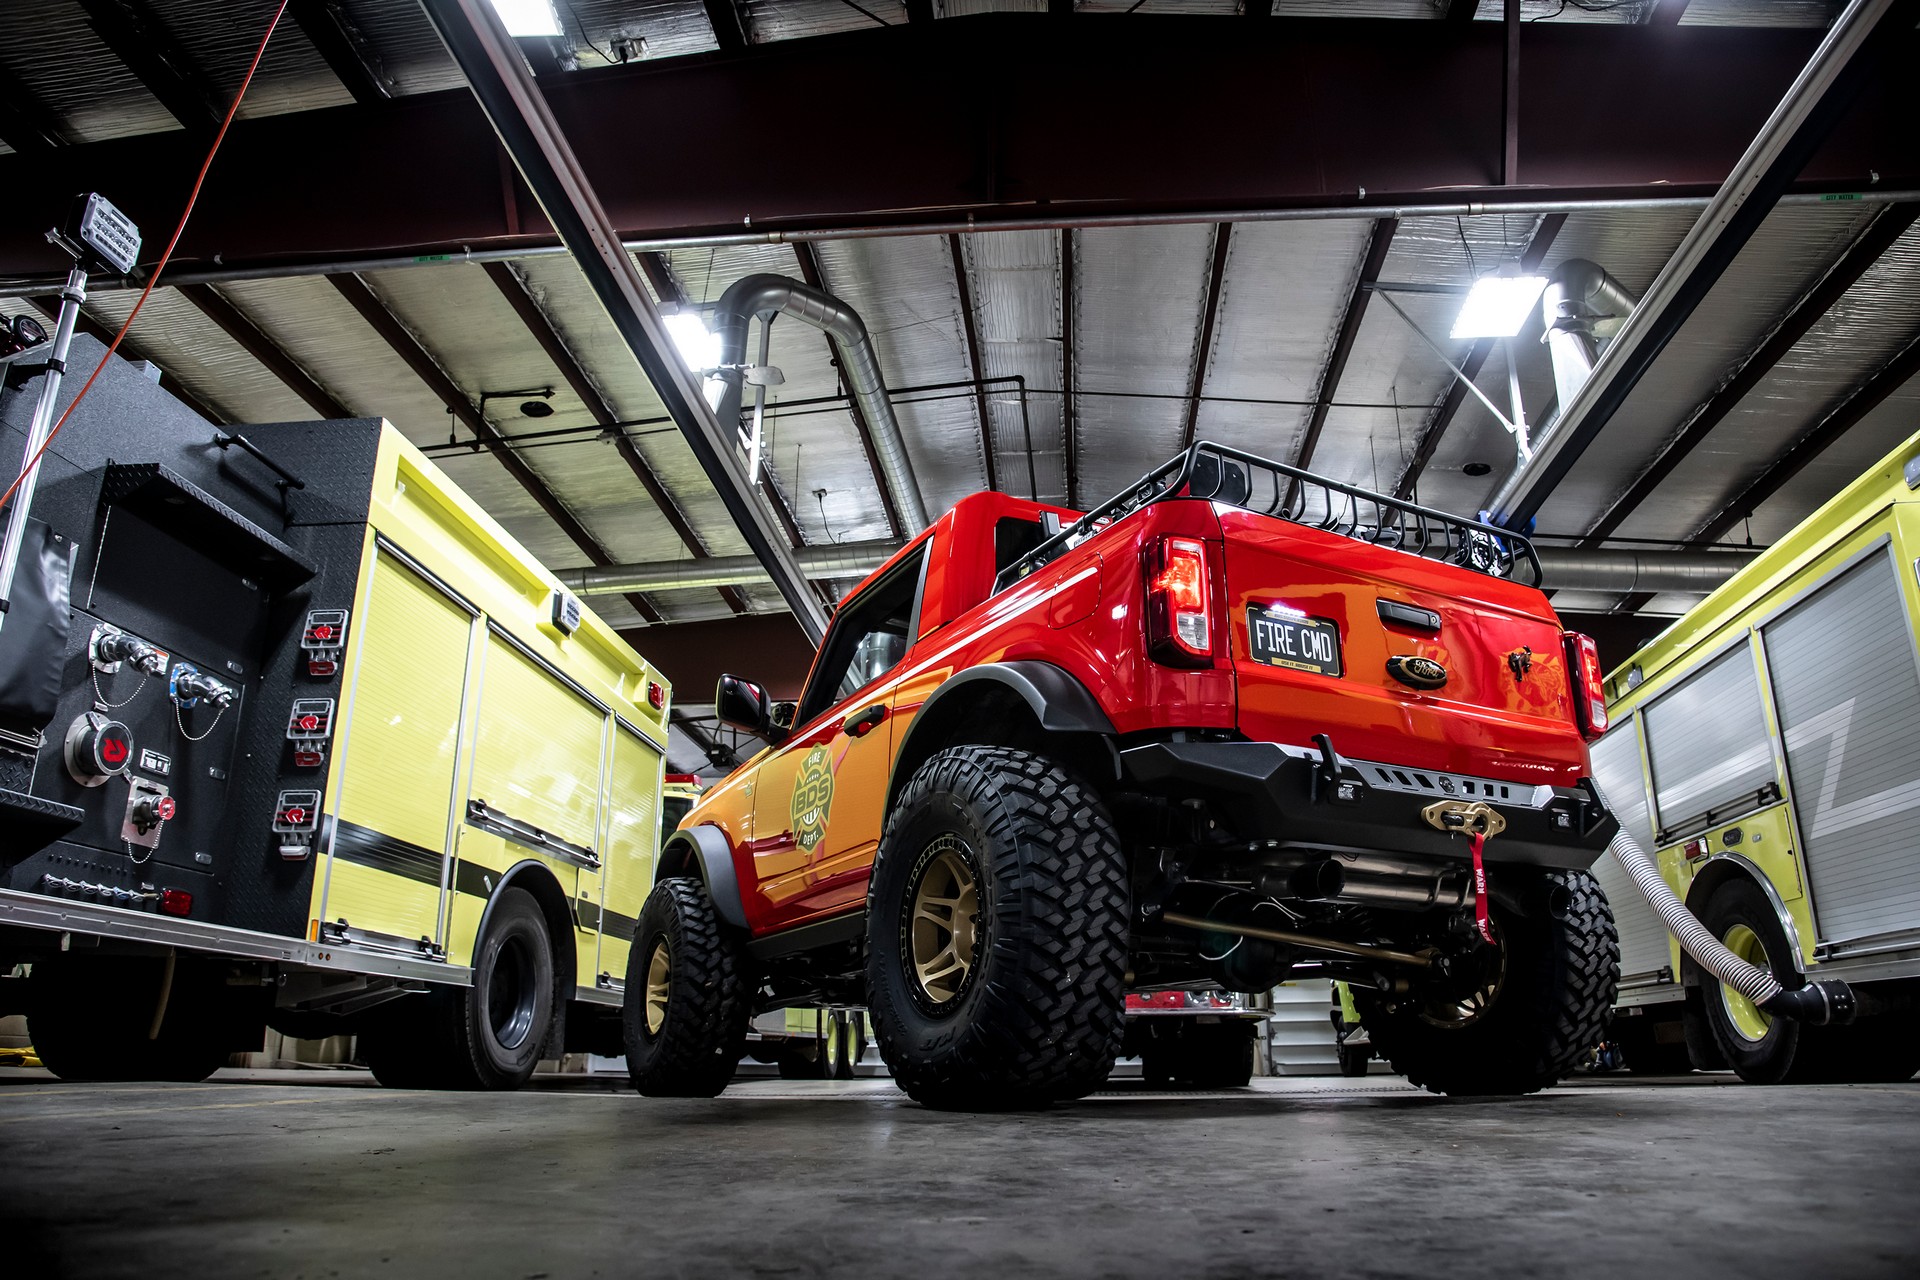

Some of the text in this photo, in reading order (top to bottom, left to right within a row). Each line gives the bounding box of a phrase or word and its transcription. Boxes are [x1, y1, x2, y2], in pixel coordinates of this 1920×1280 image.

[1255, 619, 1333, 662] FIRE CMD
[1413, 659, 1440, 677] Ford
[808, 751, 821, 767] FIRE
[795, 775, 830, 816] BDS
[803, 830, 819, 845] DEPT.
[1476, 868, 1485, 894] WARN
